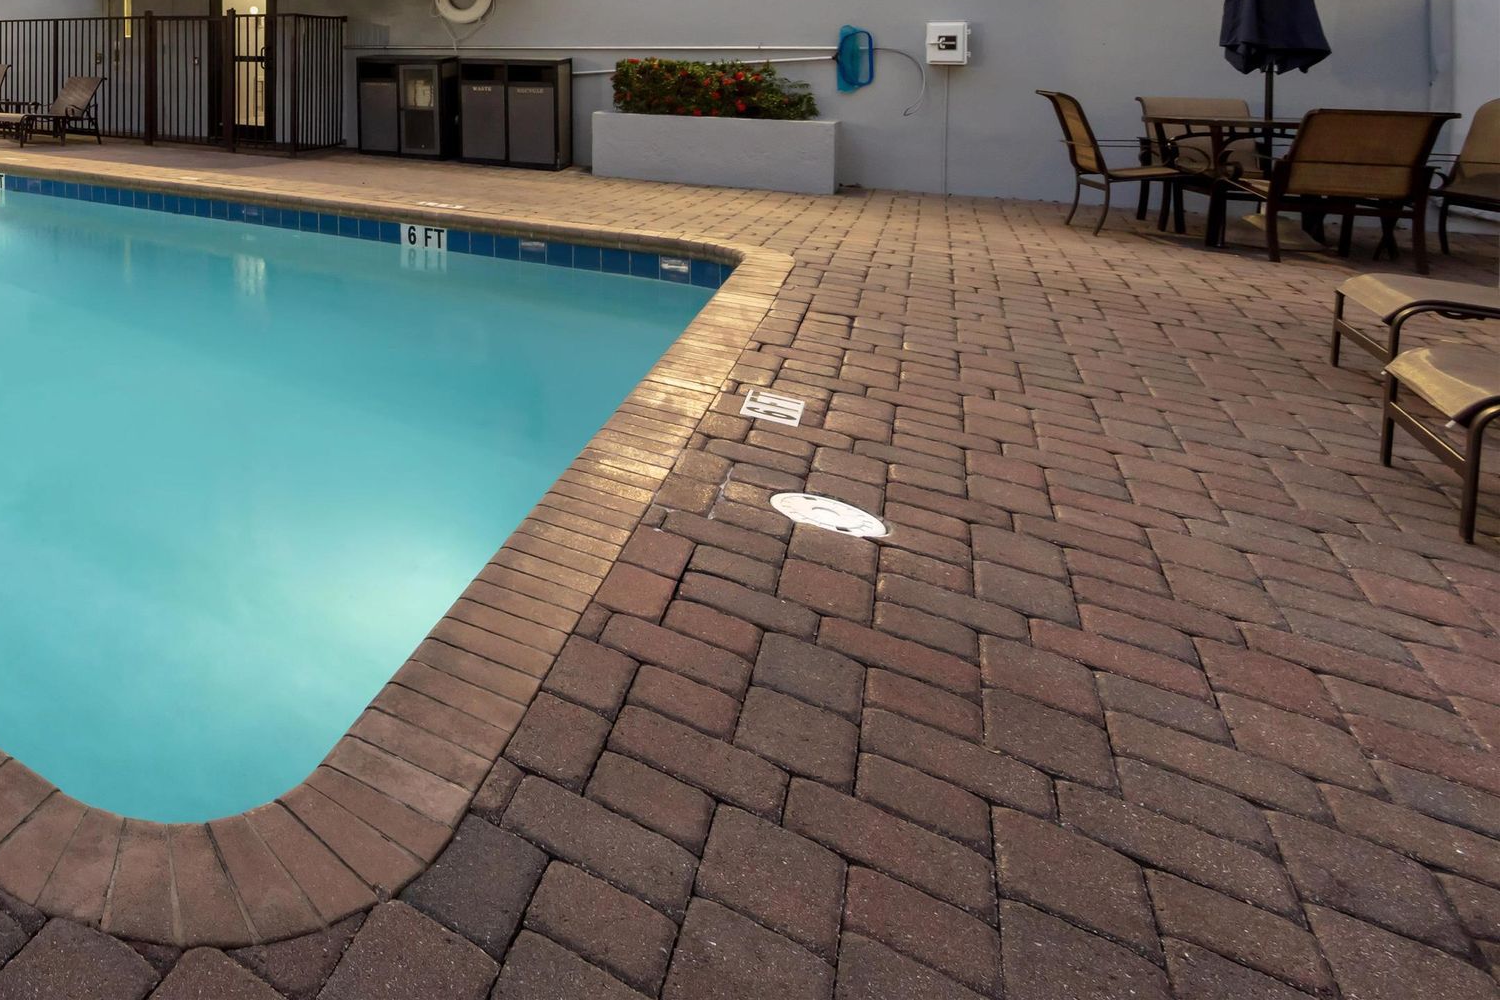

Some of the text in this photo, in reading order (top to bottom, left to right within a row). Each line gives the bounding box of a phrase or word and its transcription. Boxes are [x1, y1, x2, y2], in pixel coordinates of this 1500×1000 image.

[408, 225, 445, 249] 6 FT
[746, 391, 802, 421] 6 FT
